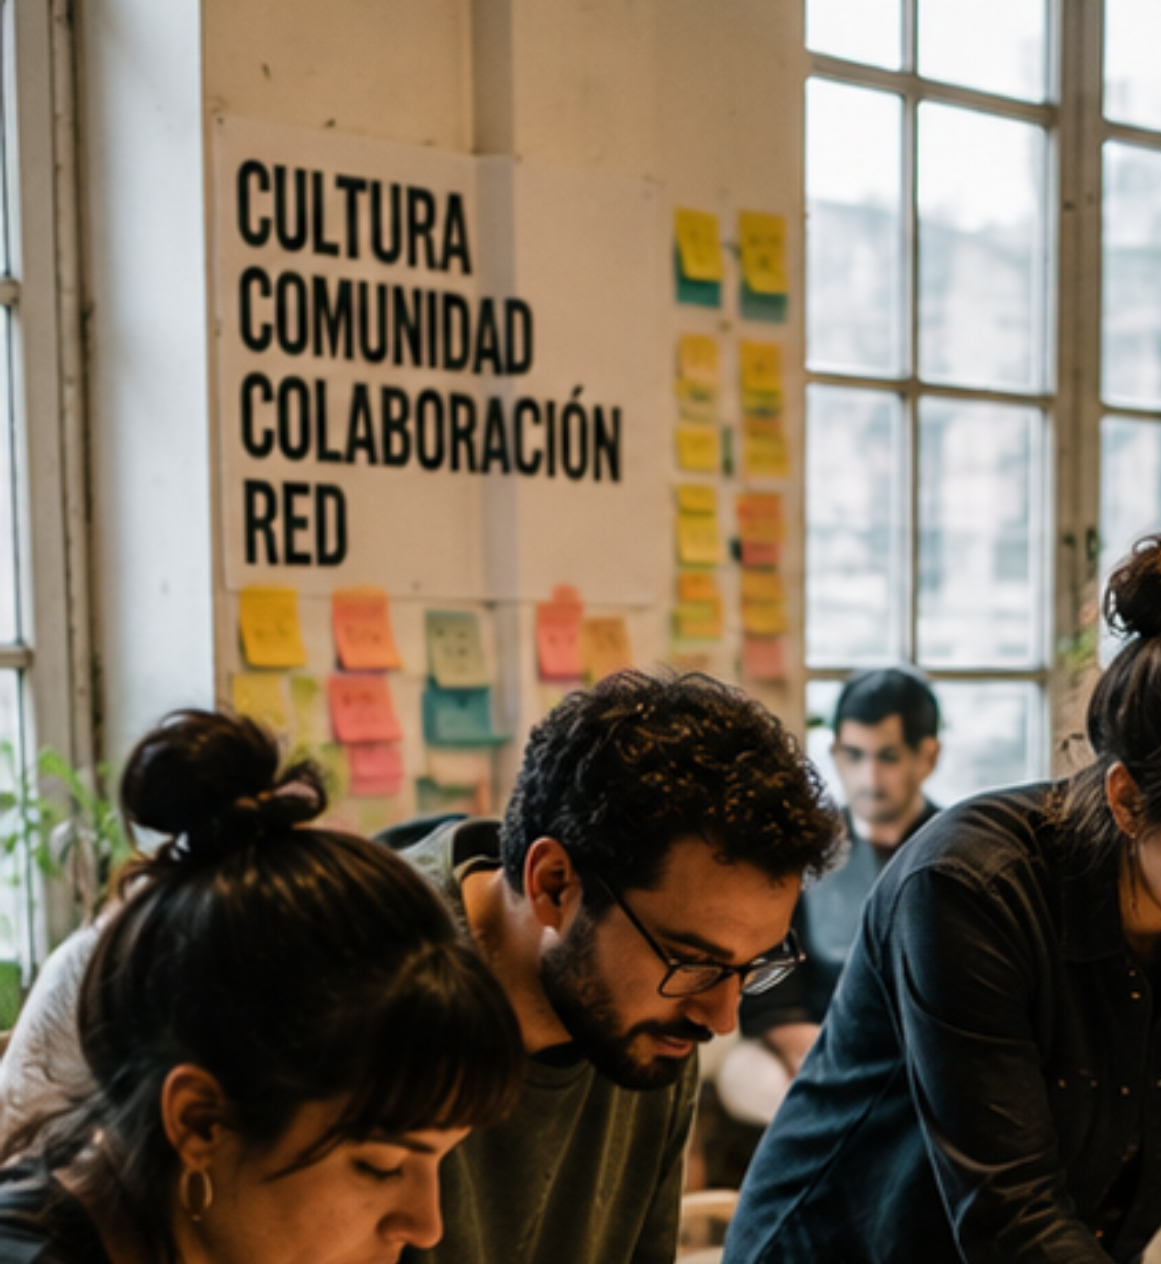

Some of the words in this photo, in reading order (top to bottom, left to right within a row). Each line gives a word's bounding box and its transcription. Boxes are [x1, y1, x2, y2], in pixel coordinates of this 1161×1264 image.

[236, 158, 472, 275] CULTURA
[238, 265, 534, 377] COMUNIDAD
[240, 371, 622, 483] COLABORACIÓN
[243, 478, 347, 568] RED
